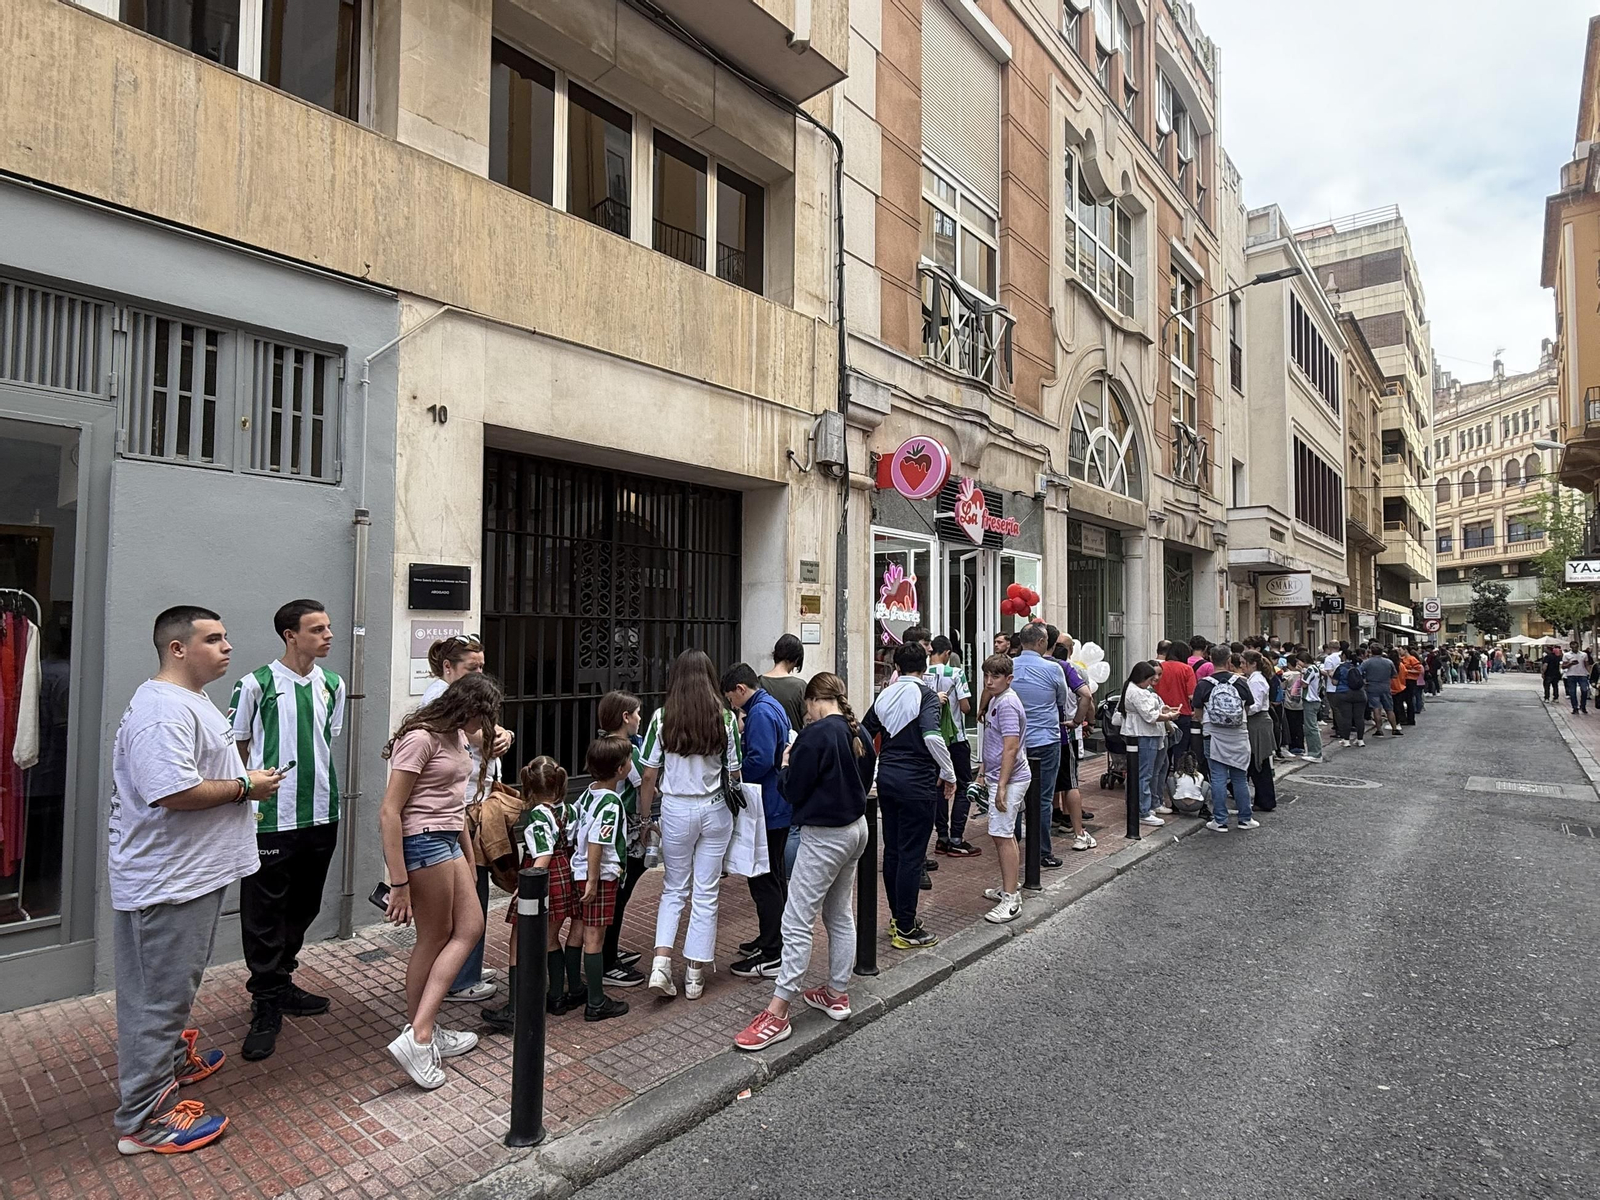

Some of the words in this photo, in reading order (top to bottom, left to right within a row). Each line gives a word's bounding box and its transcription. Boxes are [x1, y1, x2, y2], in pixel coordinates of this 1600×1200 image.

[426, 404, 448, 424] 10
[960, 501, 978, 525] La
[1270, 580, 1298, 590] SMART
[426, 628, 461, 636] KELSEN
